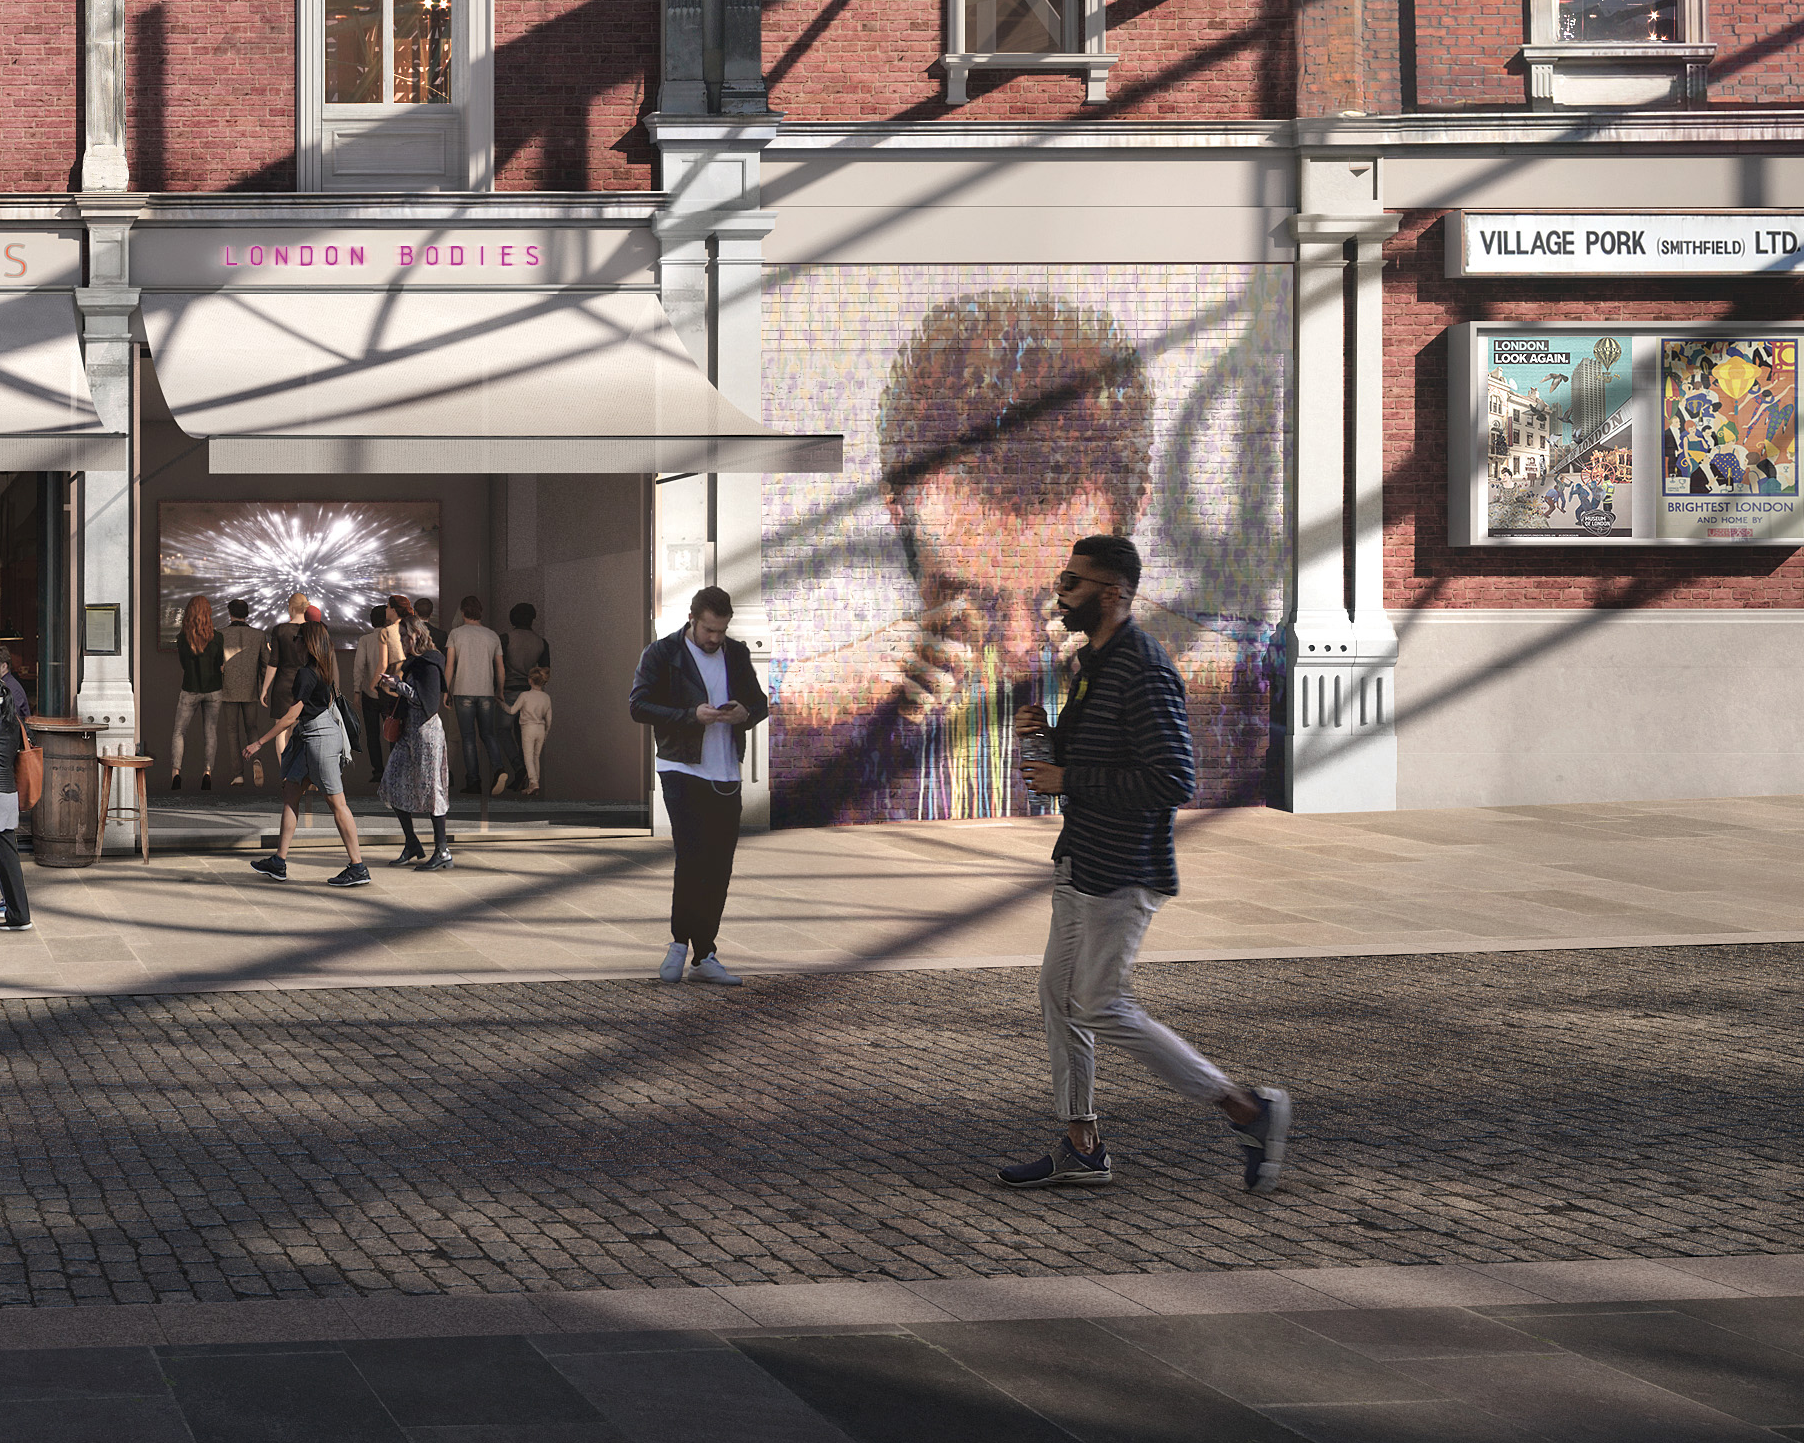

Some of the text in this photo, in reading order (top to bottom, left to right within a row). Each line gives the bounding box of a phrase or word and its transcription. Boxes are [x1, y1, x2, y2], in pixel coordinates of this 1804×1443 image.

[1480, 230, 1575, 255] VILLAGE
[1586, 230, 1646, 255] PORK
[1656, 237, 1746, 257] (SMITHFIELD)
[226, 245, 540, 266] LONDON BODIES
[1495, 341, 1548, 351] LONDON.
[1495, 354, 1569, 364] LOOK AGAIN.
[1578, 410, 1624, 453] LONDON
[1668, 502, 1794, 513] BRIGHTEST LONDON
